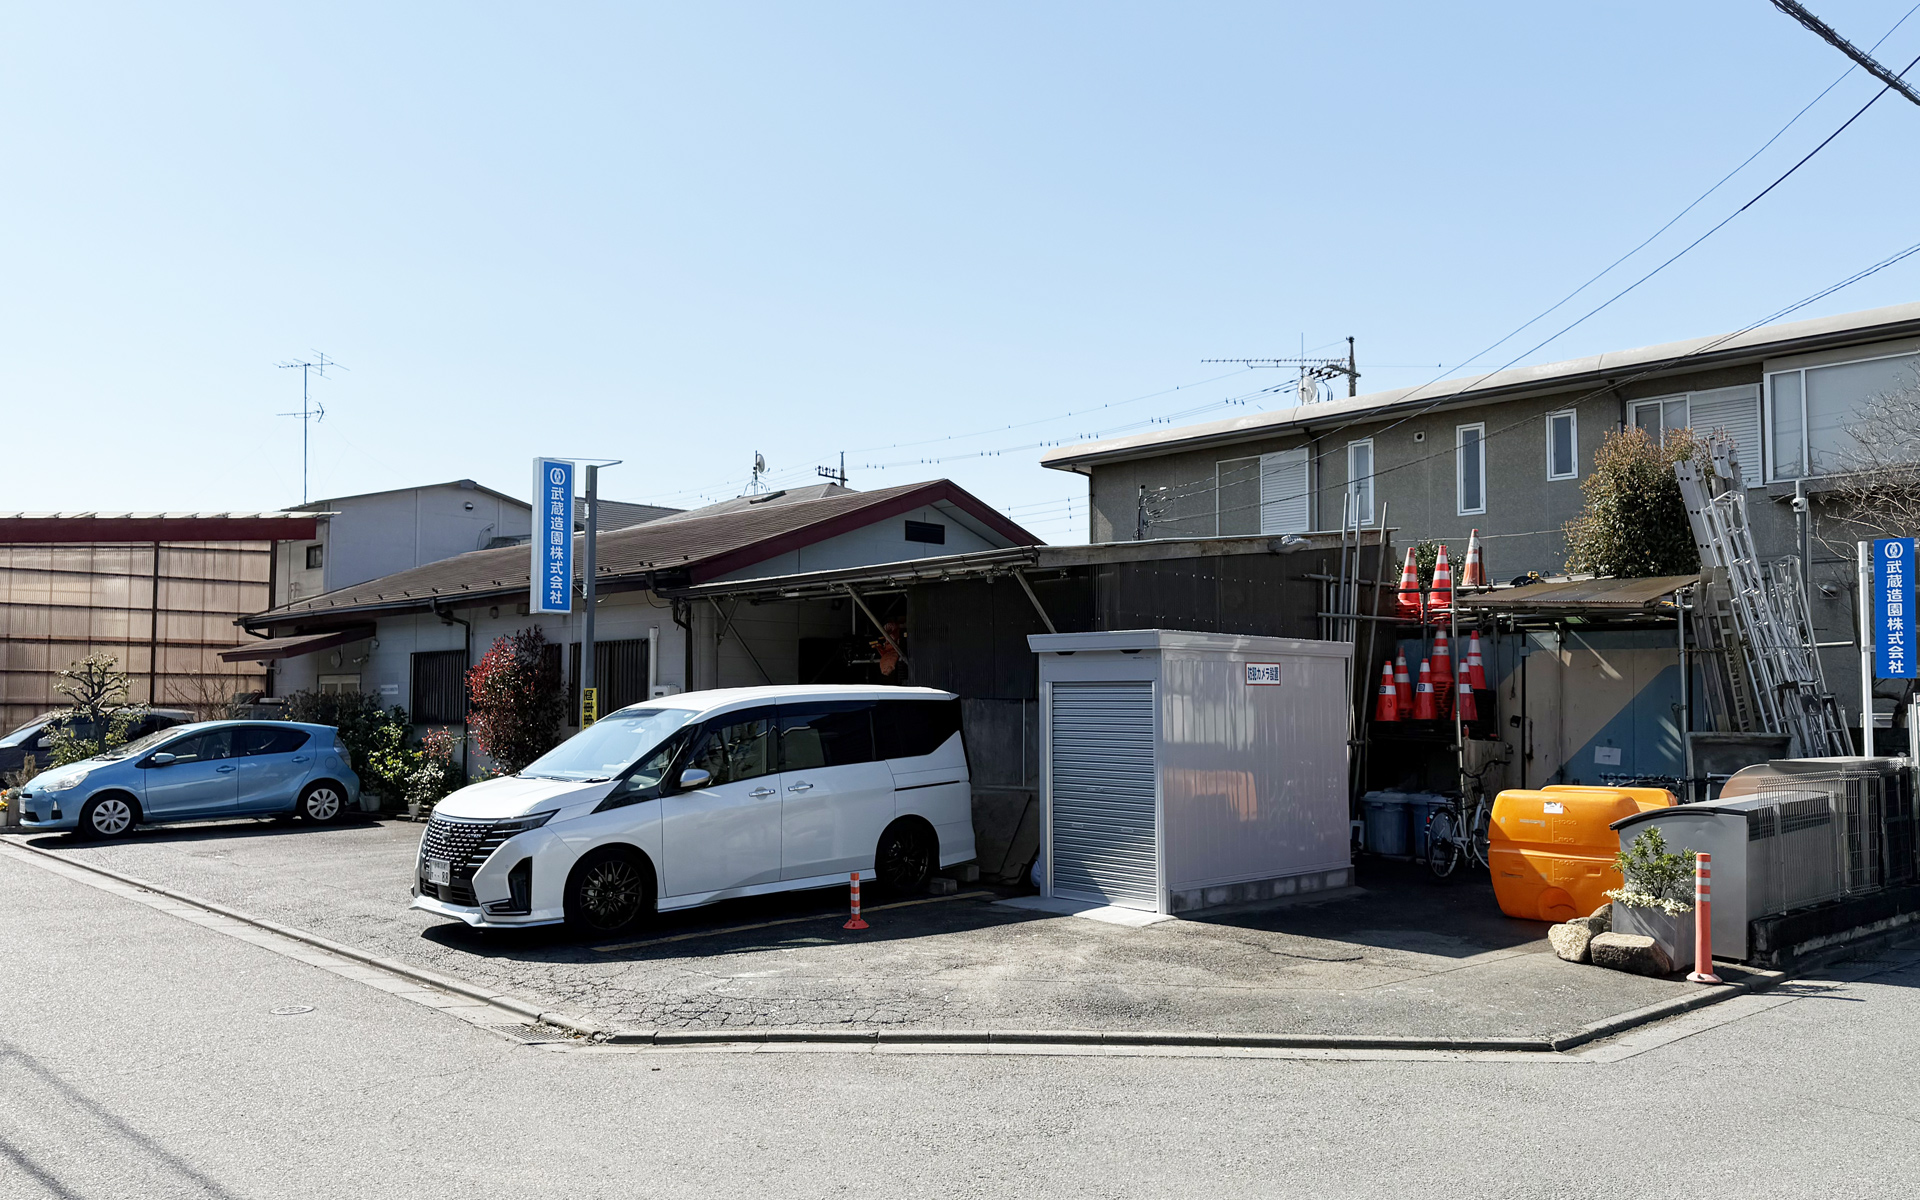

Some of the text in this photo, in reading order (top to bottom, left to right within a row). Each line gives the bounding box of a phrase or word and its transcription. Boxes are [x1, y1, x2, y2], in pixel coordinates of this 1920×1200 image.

[549, 486, 565, 605] 武蔵造園株式会社
[1247, 666, 1279, 681] 防犯カメラ設置
[1886, 560, 1905, 674] 武蔵造園株式会社
